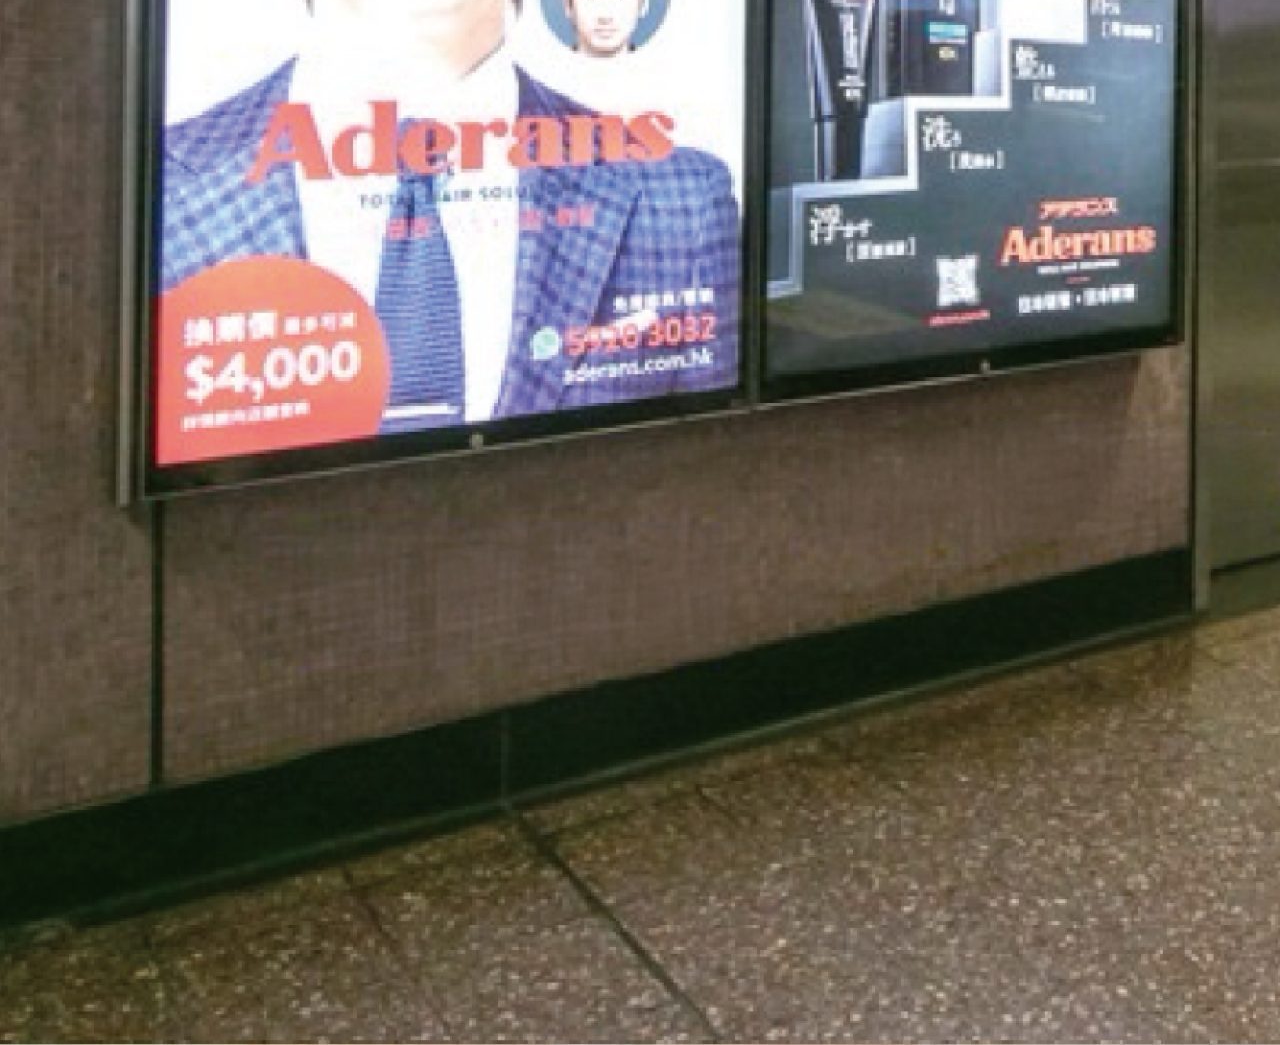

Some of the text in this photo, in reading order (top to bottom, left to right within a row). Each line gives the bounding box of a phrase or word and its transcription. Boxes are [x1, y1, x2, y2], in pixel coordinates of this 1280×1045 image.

[243, 99, 676, 185] Aderans
[999, 225, 1158, 266] Aderans
[184, 340, 362, 405] $4,000
[563, 348, 715, 385] aderans.com.hk
